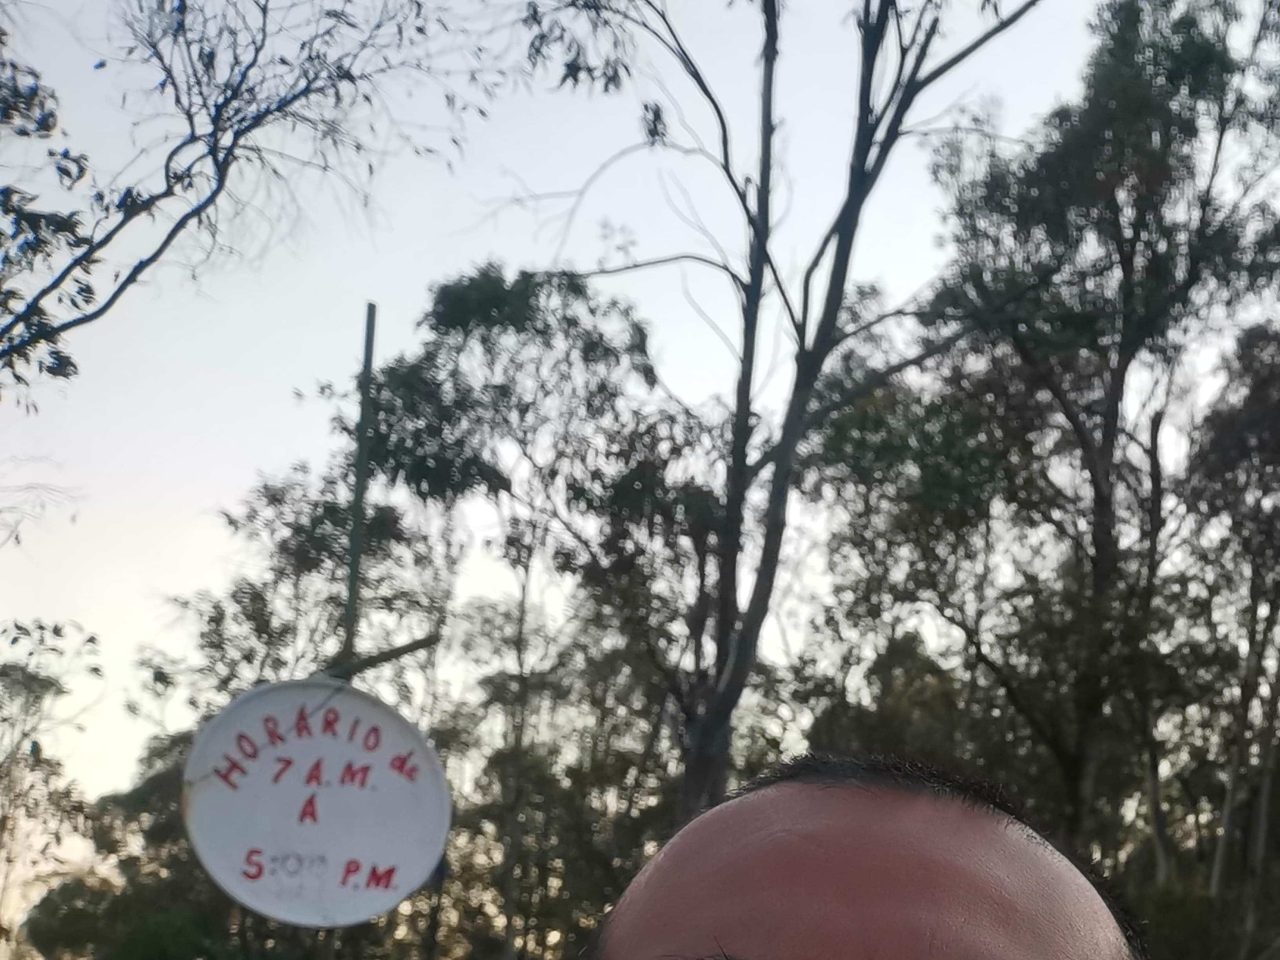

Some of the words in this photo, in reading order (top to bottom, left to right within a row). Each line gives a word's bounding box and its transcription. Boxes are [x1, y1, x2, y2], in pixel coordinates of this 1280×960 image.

[213, 704, 382, 790] HORARIO
[271, 756, 294, 784] 7
[299, 793, 318, 823] A
